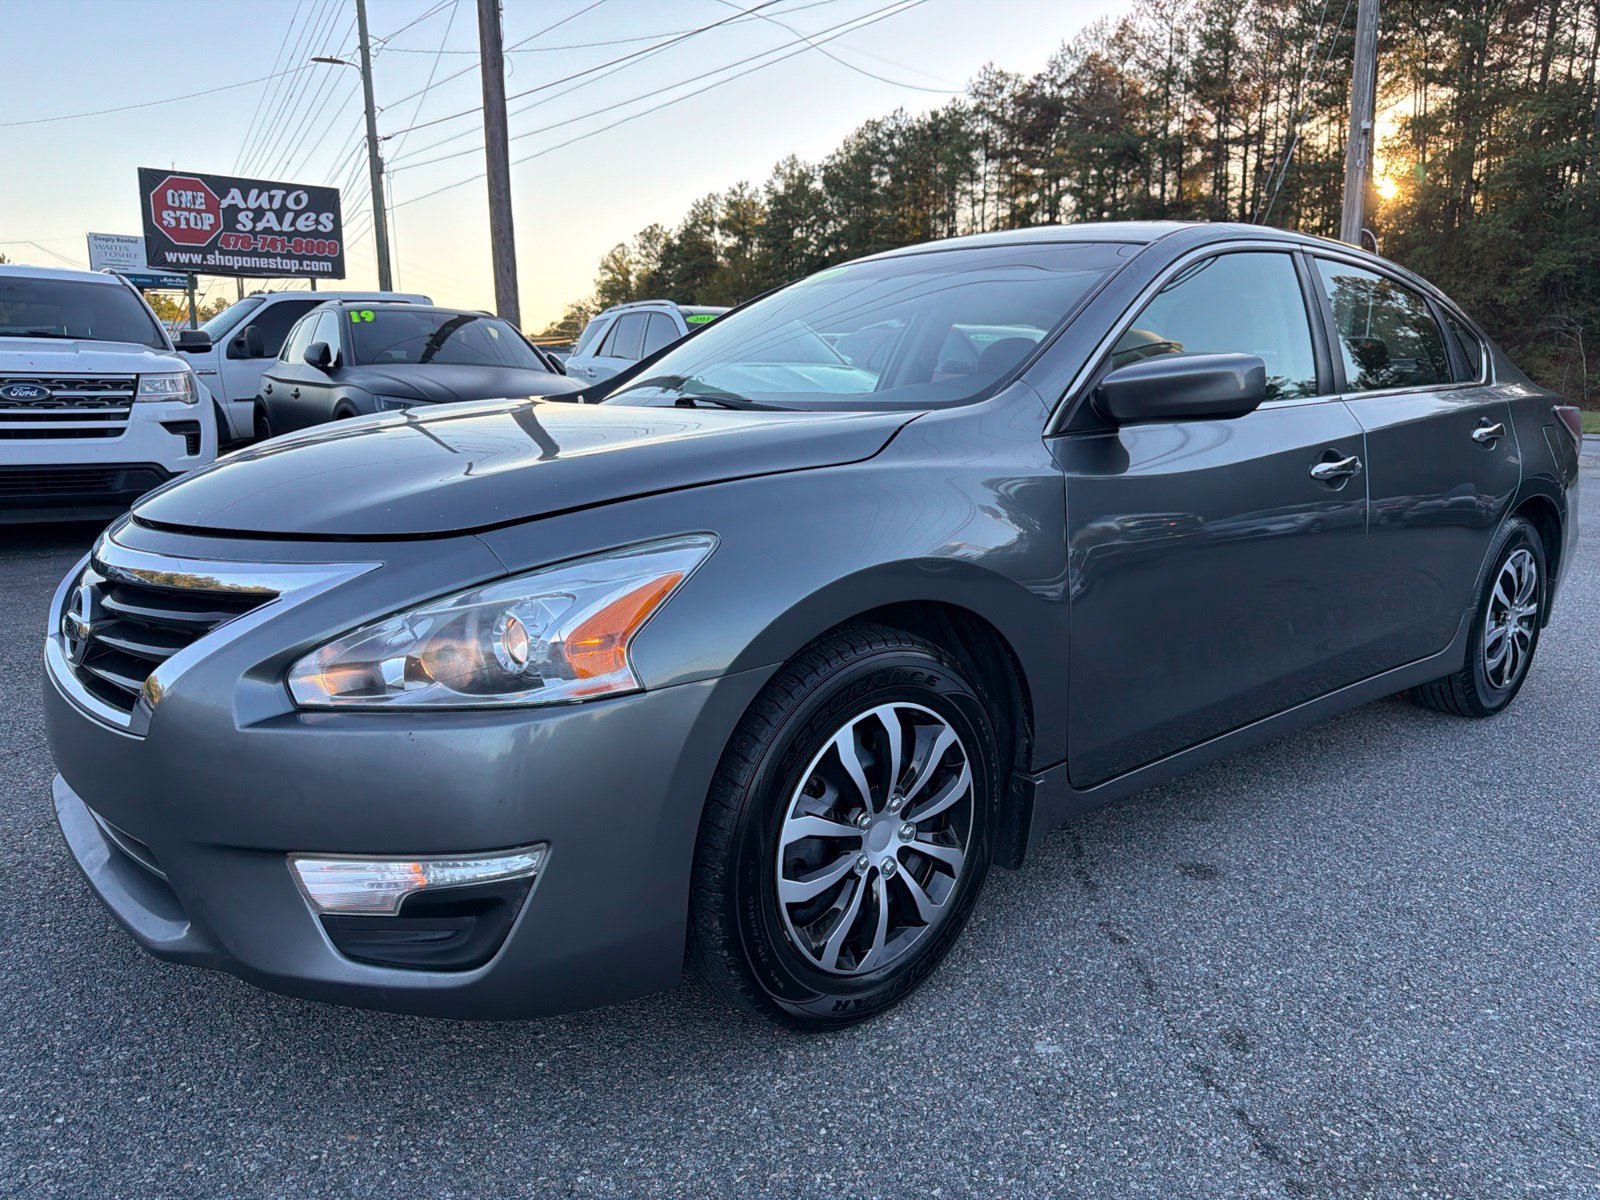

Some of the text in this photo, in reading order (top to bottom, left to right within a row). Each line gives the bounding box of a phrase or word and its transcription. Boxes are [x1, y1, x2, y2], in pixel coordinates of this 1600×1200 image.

[166, 188, 207, 210] ONE
[219, 188, 309, 210] AUTO
[162, 210, 215, 231] STOP
[93, 235, 115, 243] Deeply
[164, 250, 333, 272] www.shoponestop.com
[350, 309, 375, 323] 19
[10, 386, 38, 397] Ford
